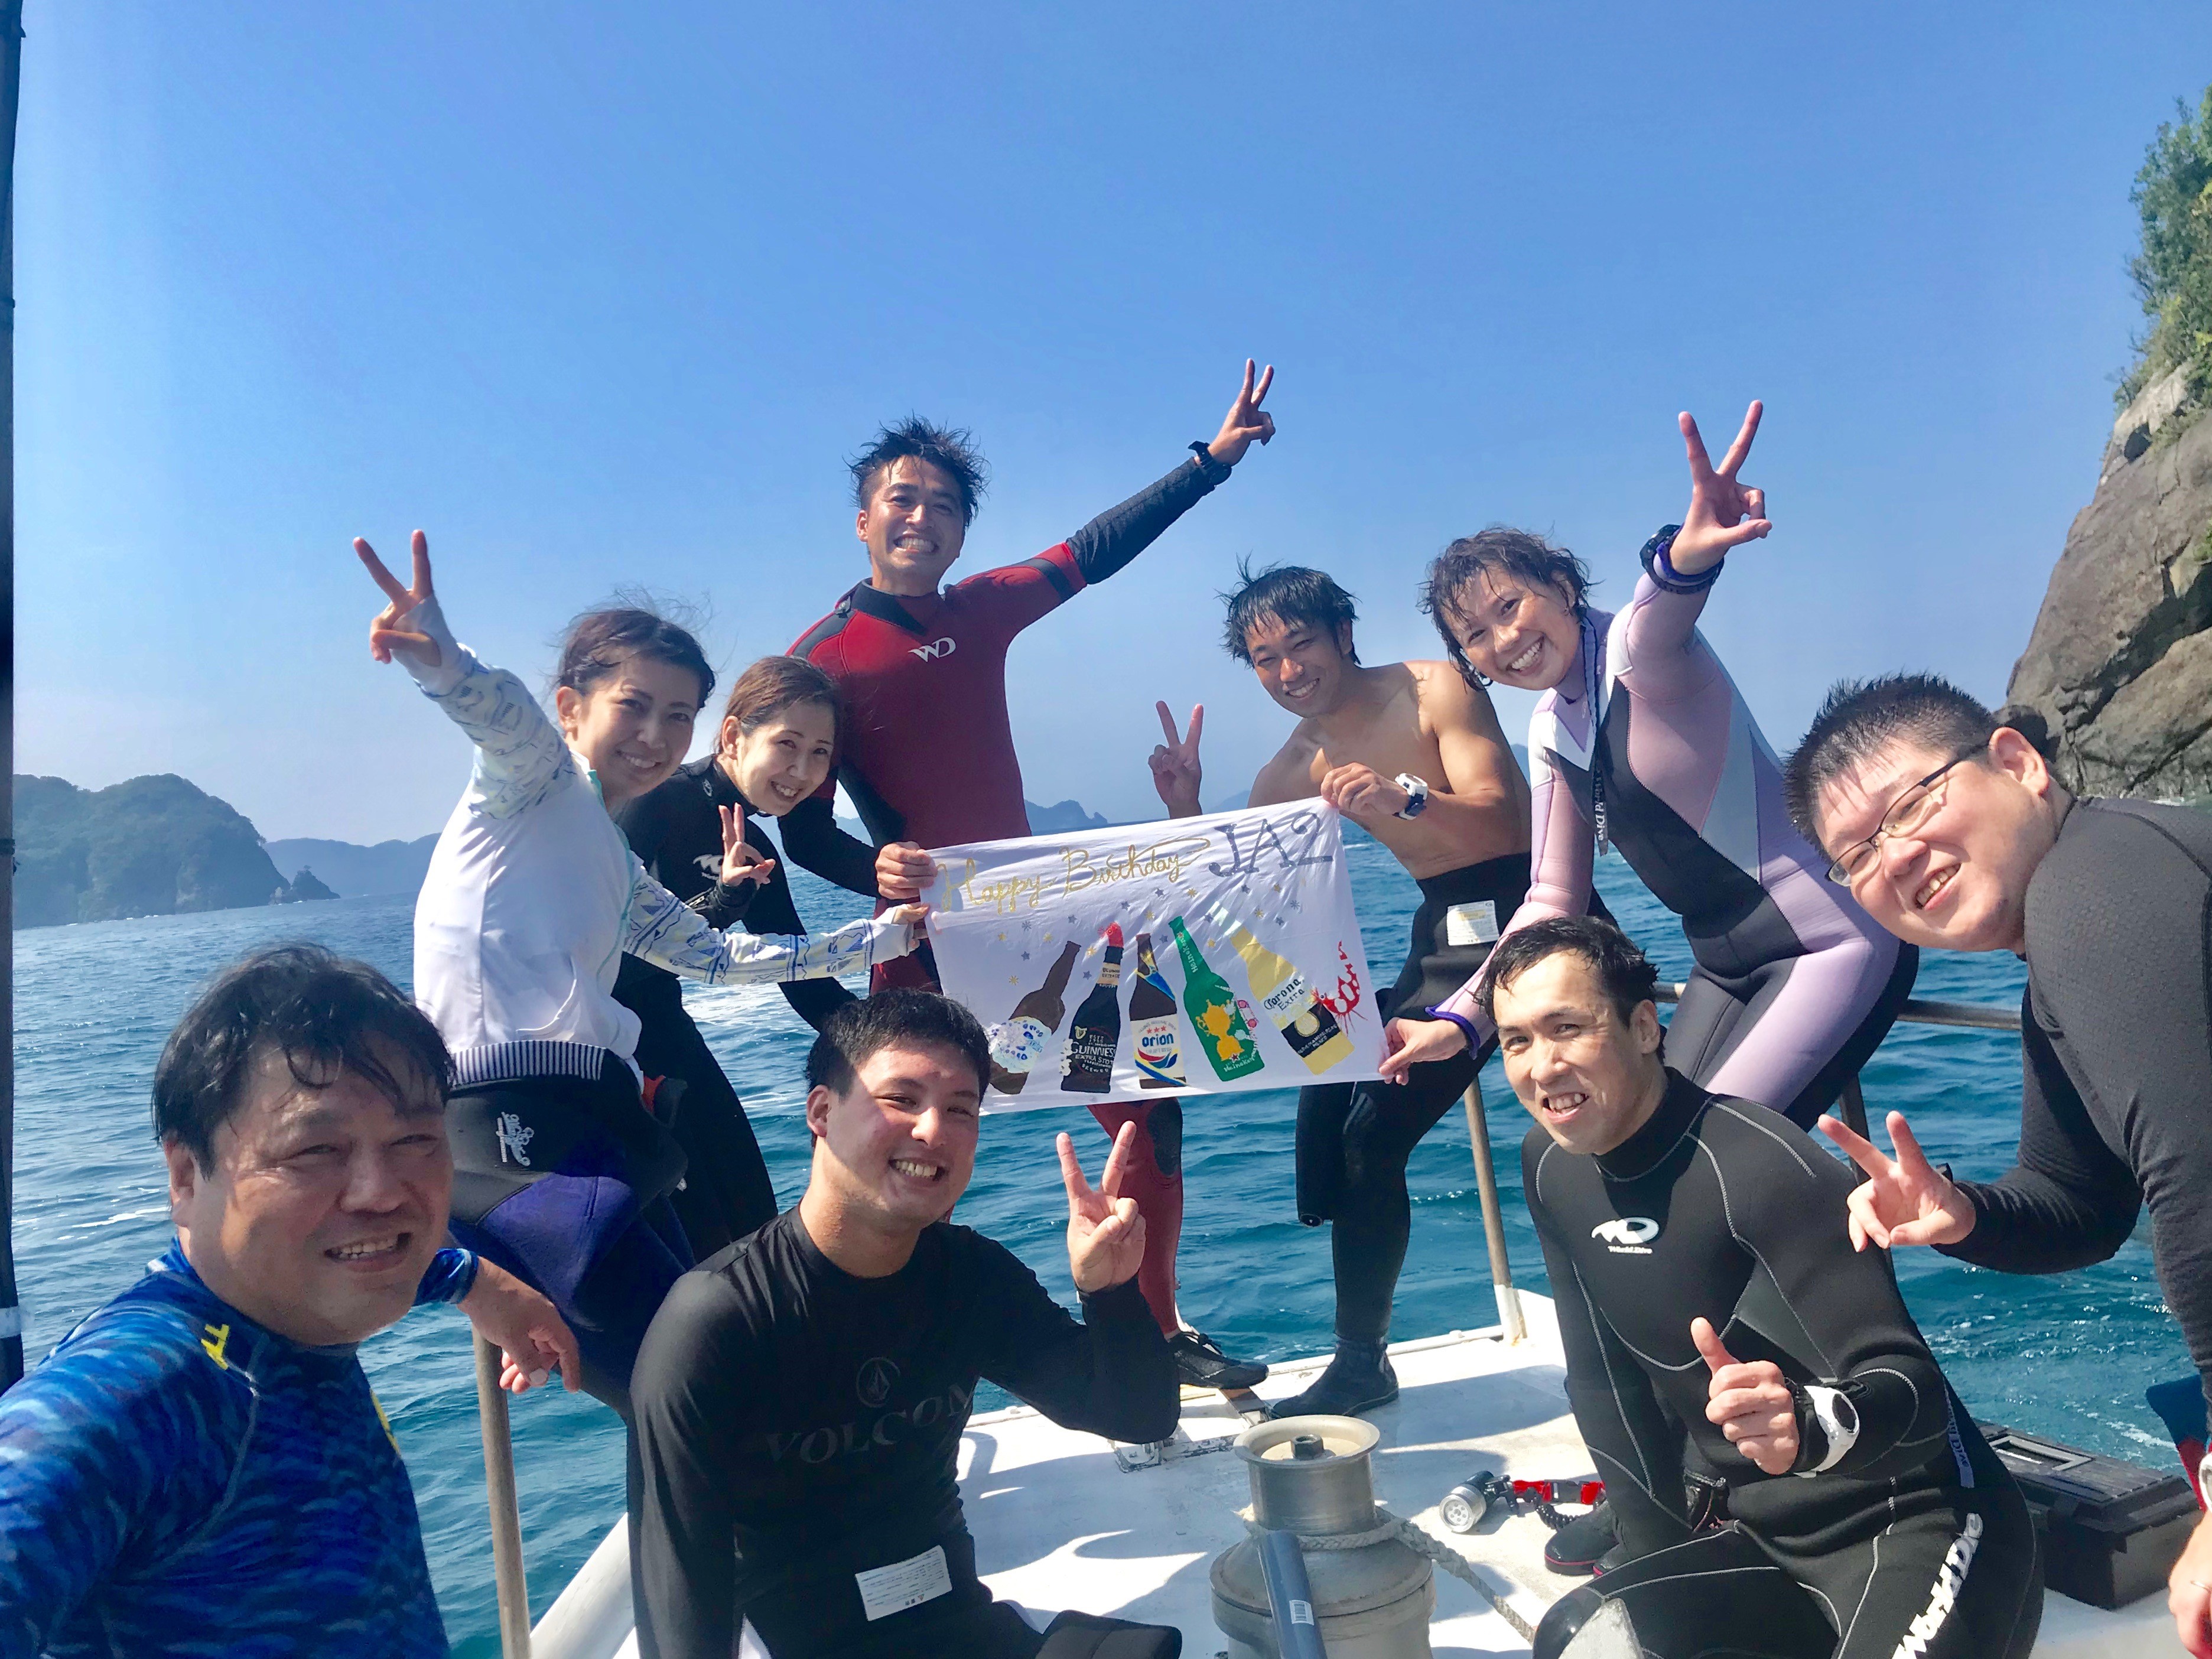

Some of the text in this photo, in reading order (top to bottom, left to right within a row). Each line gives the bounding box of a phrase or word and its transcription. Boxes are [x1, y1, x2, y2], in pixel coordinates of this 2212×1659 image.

[1595, 814, 1605, 841] Dive
[936, 838, 1211, 915] Happy Birthday
[1264, 978, 1302, 1010] Corona
[1277, 988, 1305, 1011] Extra
[1141, 1033, 1174, 1047] orion
